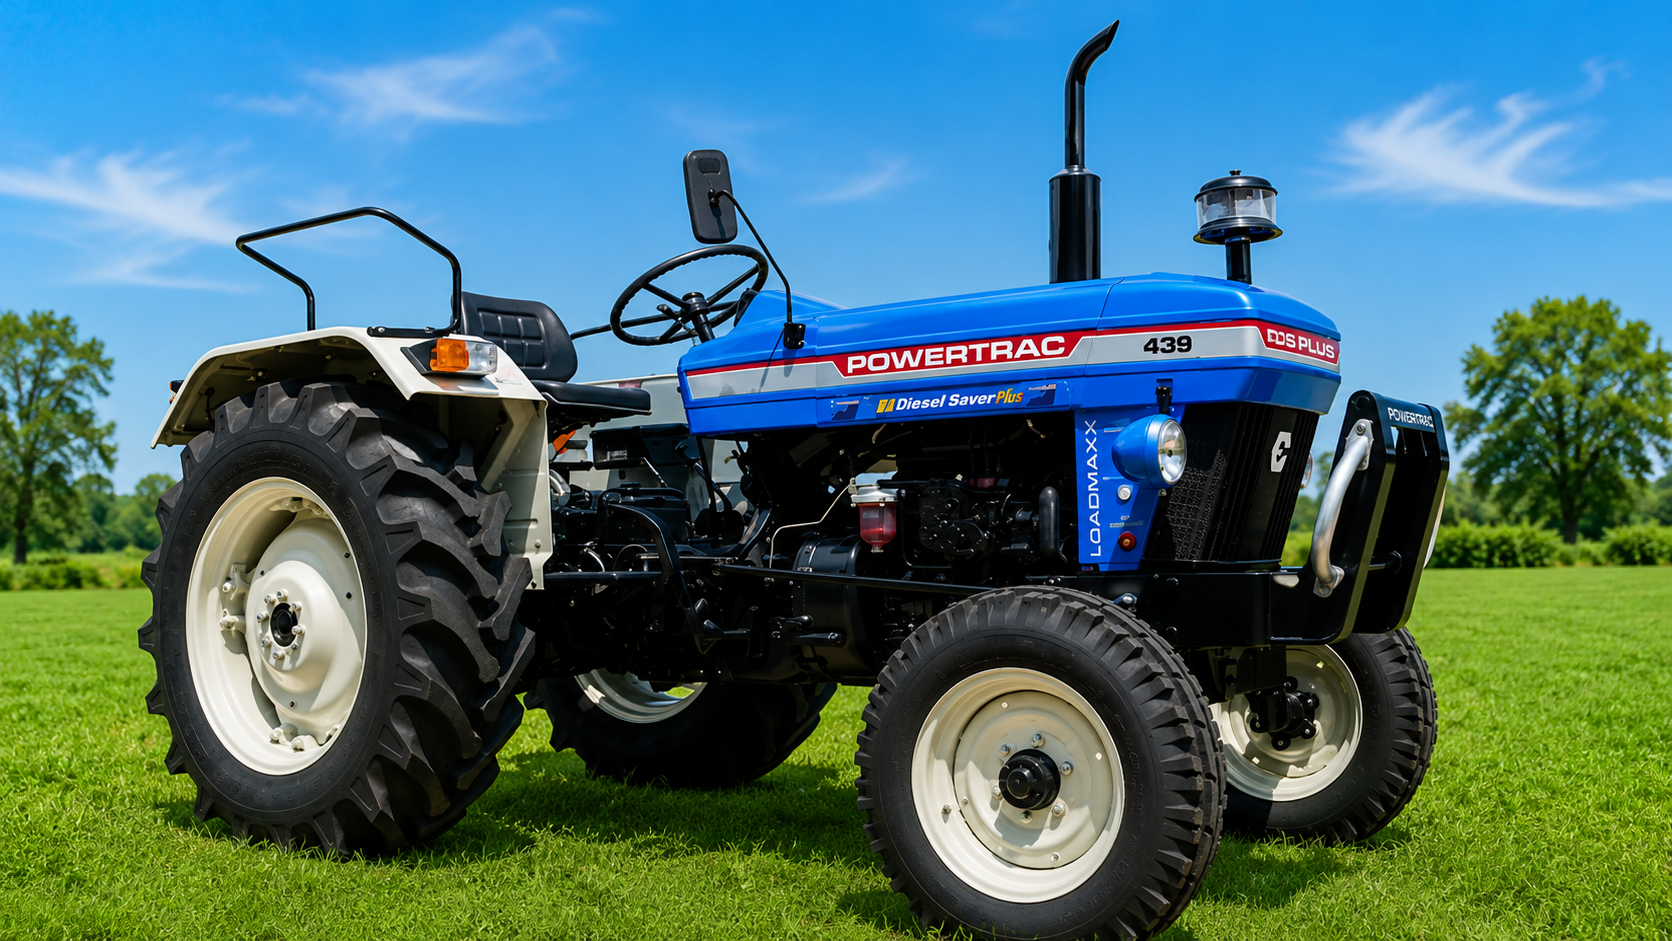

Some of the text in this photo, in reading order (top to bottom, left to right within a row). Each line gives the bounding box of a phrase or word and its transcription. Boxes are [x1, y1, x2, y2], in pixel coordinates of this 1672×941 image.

[847, 336, 1066, 374] POWERTRAC
[1143, 335, 1192, 354] 439
[1298, 335, 1335, 359] PLUS
[896, 394, 946, 411] Diesel
[1085, 420, 1102, 557] LOADMAXX
